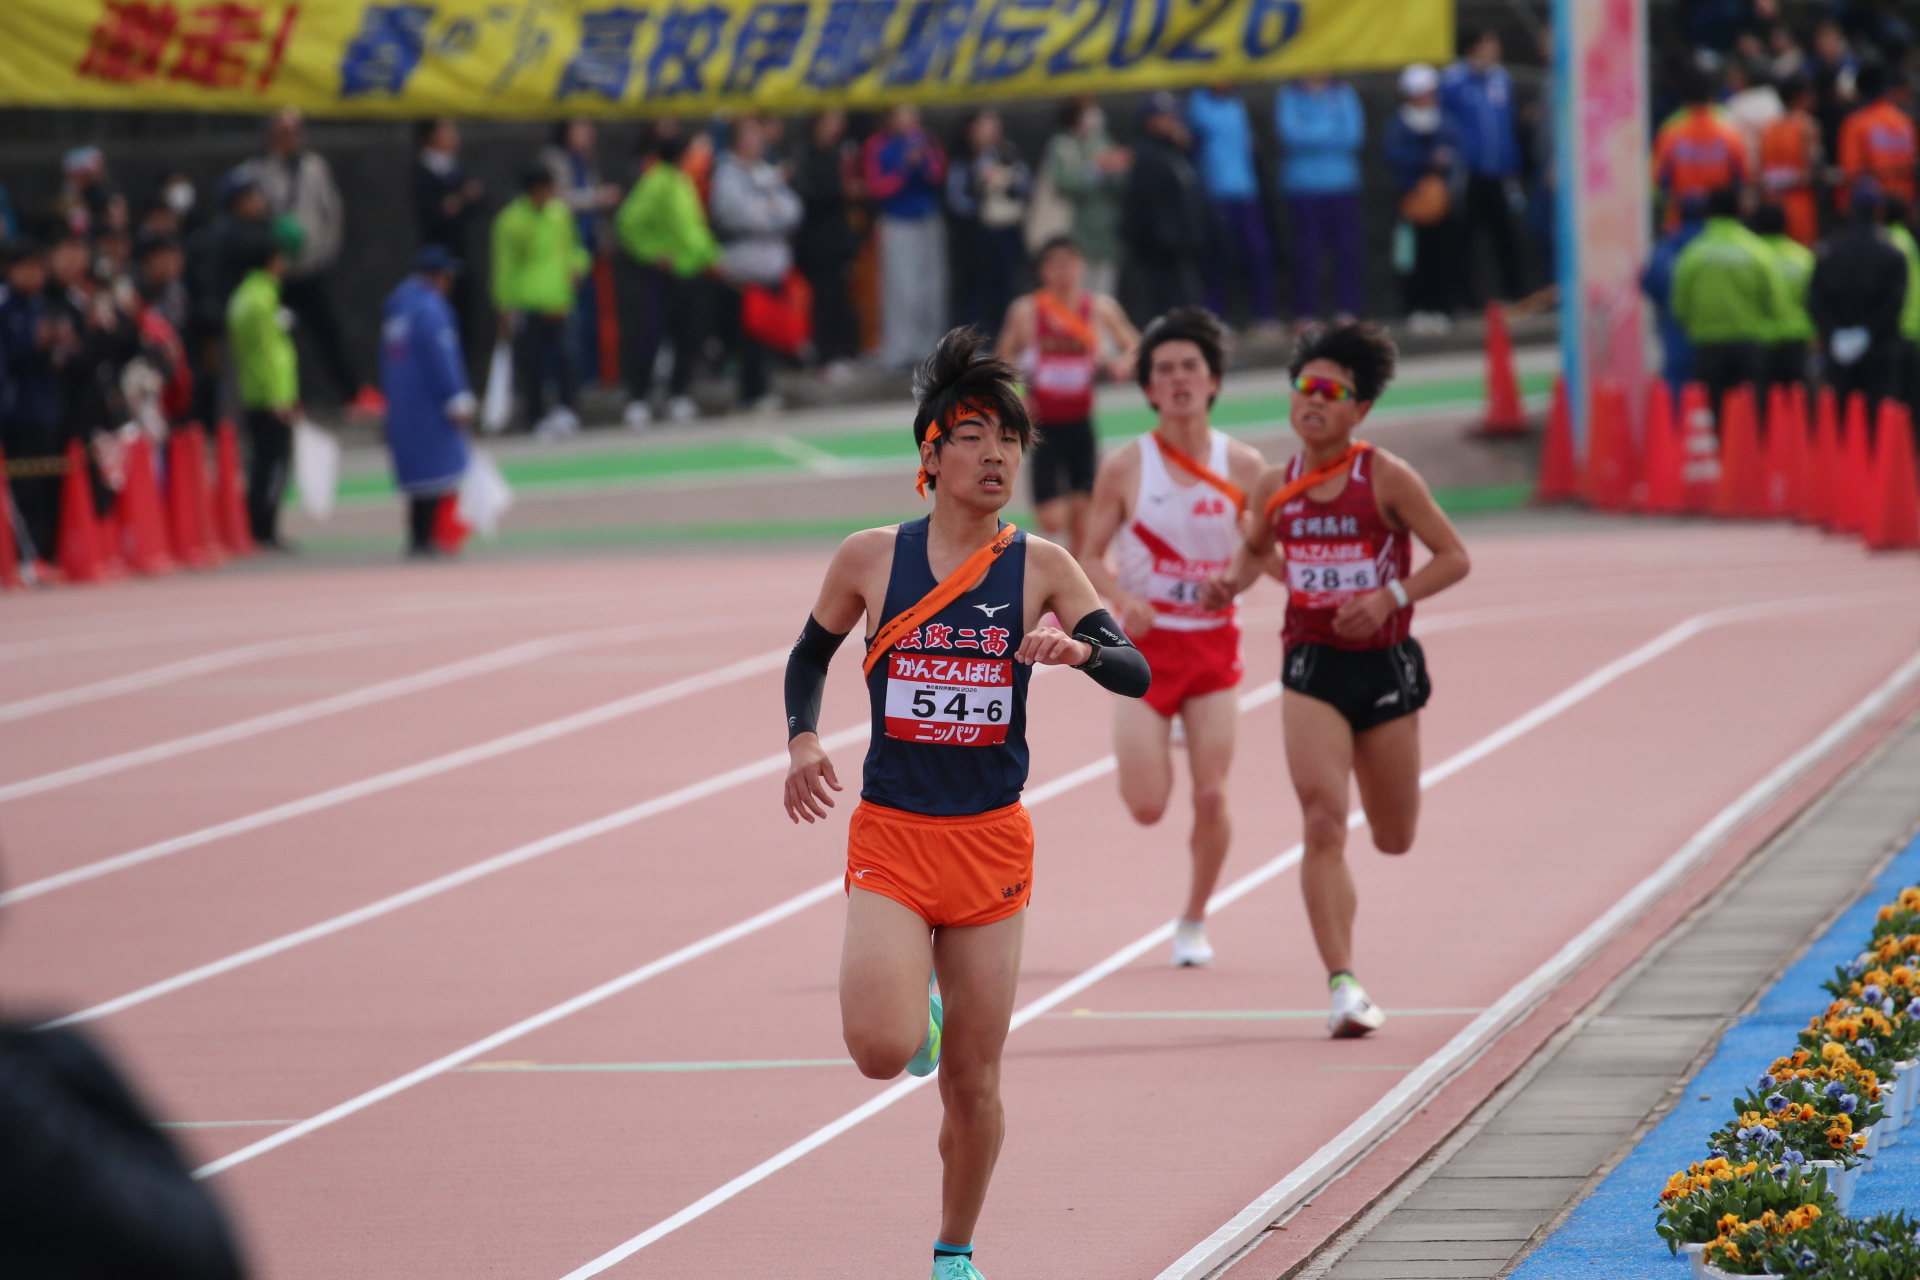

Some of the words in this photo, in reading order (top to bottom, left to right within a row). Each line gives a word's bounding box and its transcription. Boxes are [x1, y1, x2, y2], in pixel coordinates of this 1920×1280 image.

[1300, 568, 1368, 590] 28-6
[911, 689, 1003, 722] 54-6
[914, 723, 981, 743] ニッパツ
